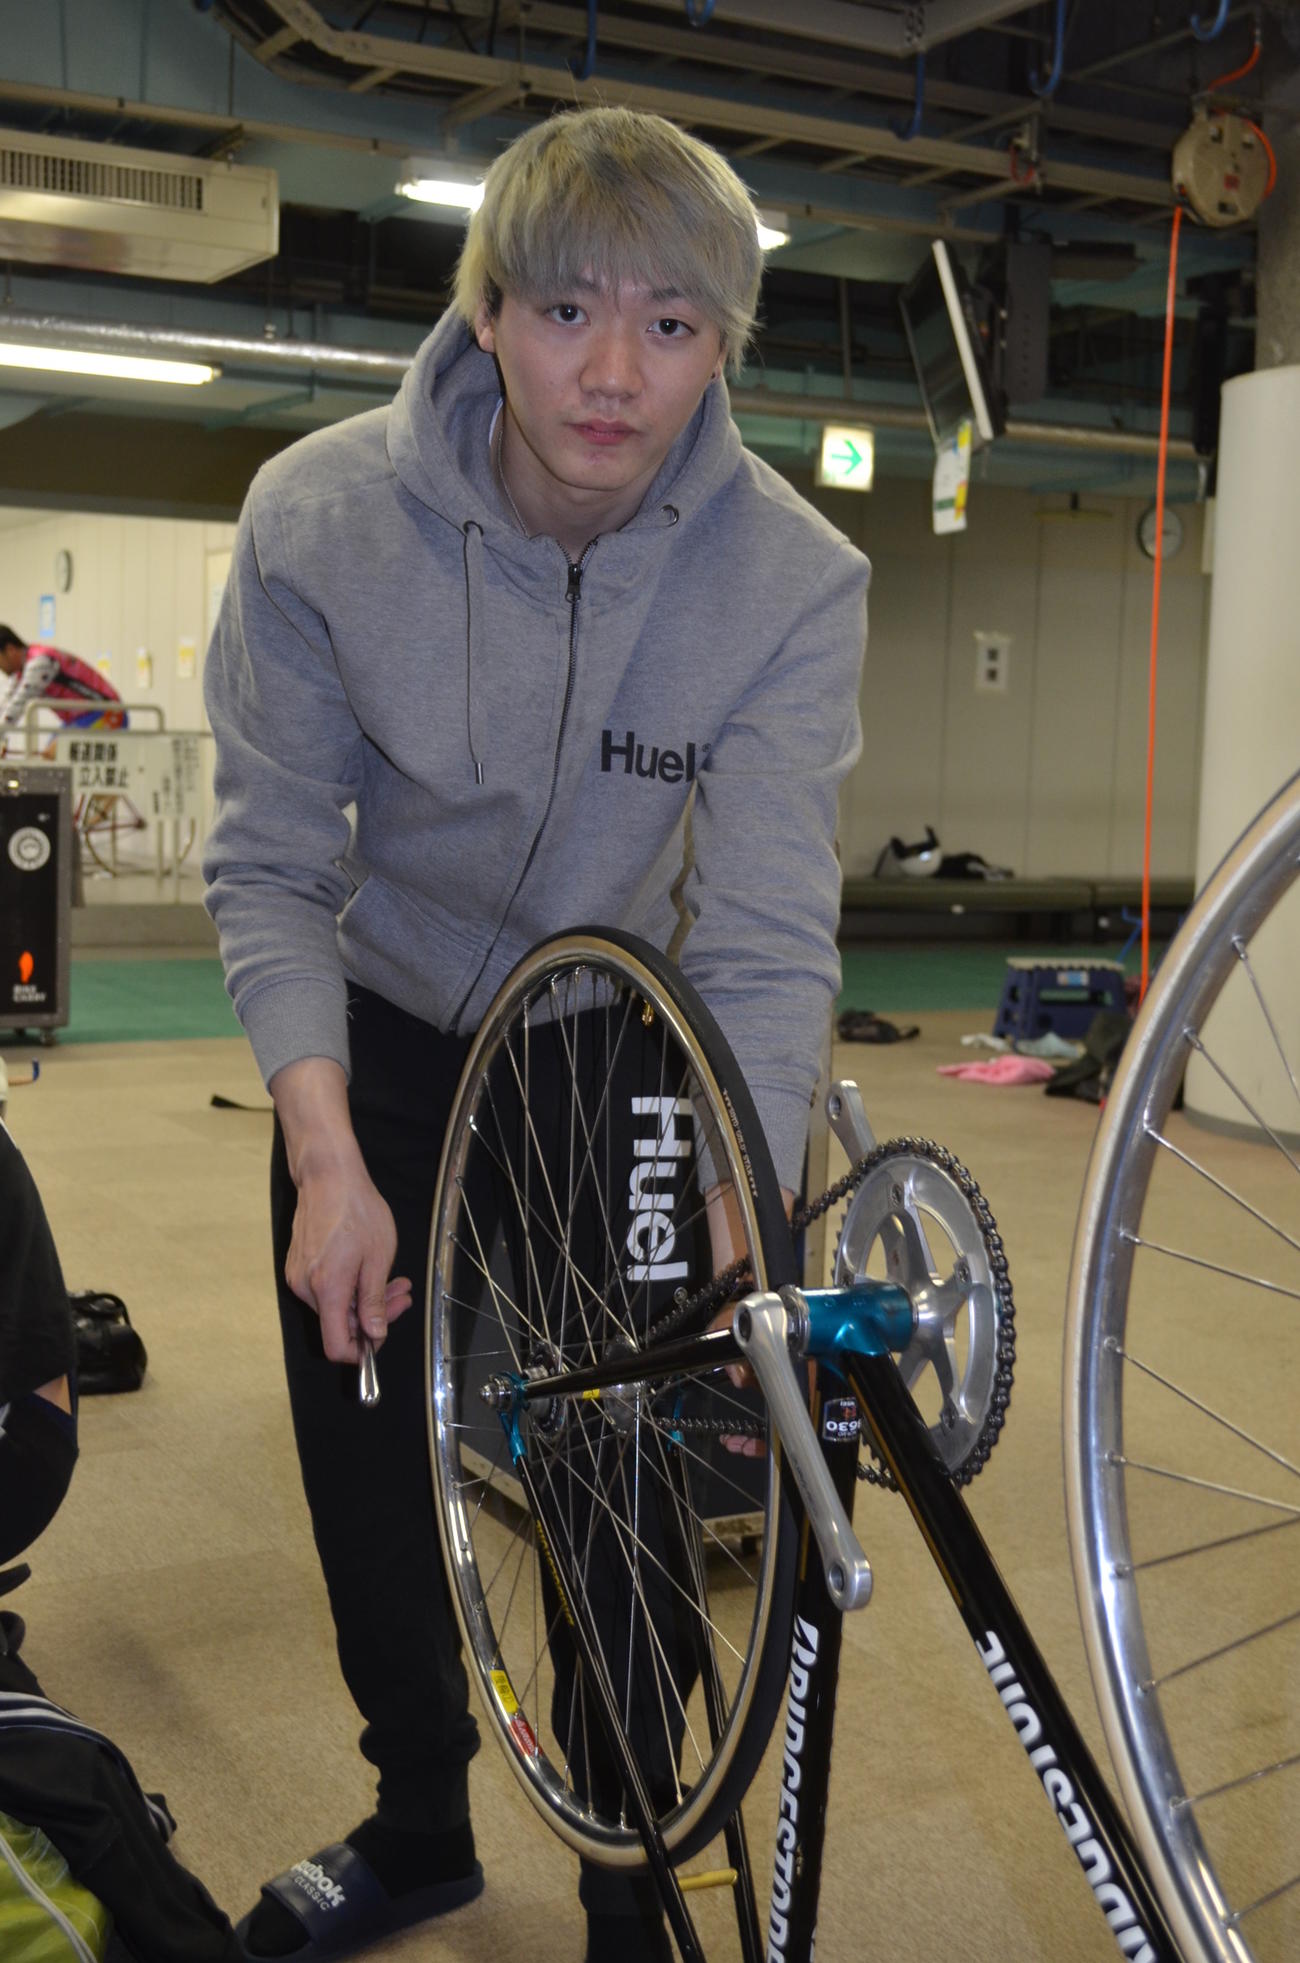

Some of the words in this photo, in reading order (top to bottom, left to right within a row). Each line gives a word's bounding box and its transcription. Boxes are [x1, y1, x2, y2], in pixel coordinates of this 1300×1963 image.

[601, 729, 696, 783] Huel
[627, 1097, 694, 1281] Huel
[294, 1875, 330, 1911] CLASSIC
